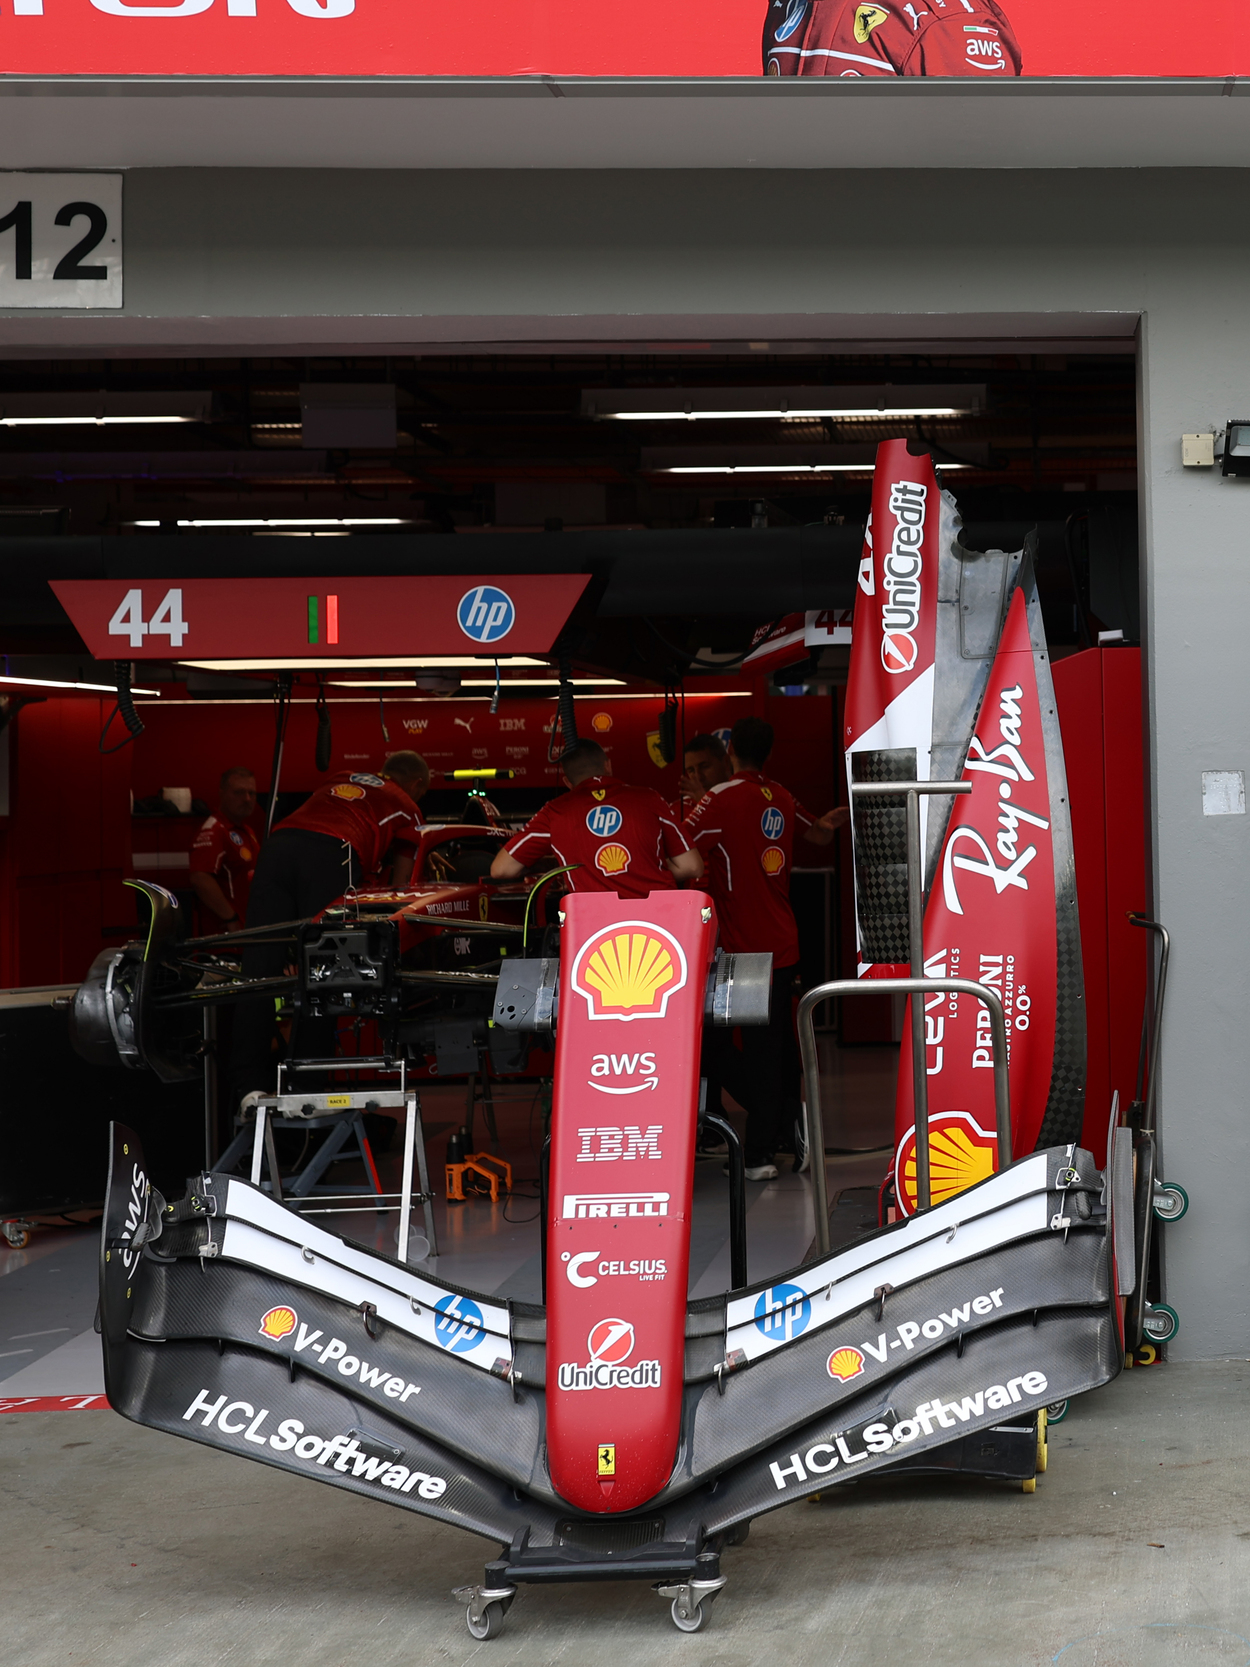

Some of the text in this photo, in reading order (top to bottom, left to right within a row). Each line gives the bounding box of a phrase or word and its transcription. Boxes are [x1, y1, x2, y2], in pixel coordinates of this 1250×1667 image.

[964, 38, 1002, 59] aws
[0, 200, 109, 280] 12
[882, 480, 928, 634] UniCredit
[108, 588, 189, 648] 44
[461, 586, 512, 642] hp
[499, 718, 526, 731] IBM
[590, 805, 618, 837] hp
[763, 807, 782, 839] hp
[425, 902, 453, 916] RICHARD
[948, 948, 961, 1018] LOGTICS
[1004, 955, 1015, 1016] AZZURRO
[590, 1052, 657, 1077] aws
[576, 1125, 664, 1163] IBM
[562, 1192, 671, 1220] PIRELLI
[598, 1259, 668, 1276] CELSIUS
[639, 1273, 666, 1282] LIVE FIT
[762, 1284, 809, 1341] hp
[860, 1286, 1006, 1363] V-Power
[292, 1321, 422, 1403] V-Power
[558, 1360, 662, 1391] UniCredit
